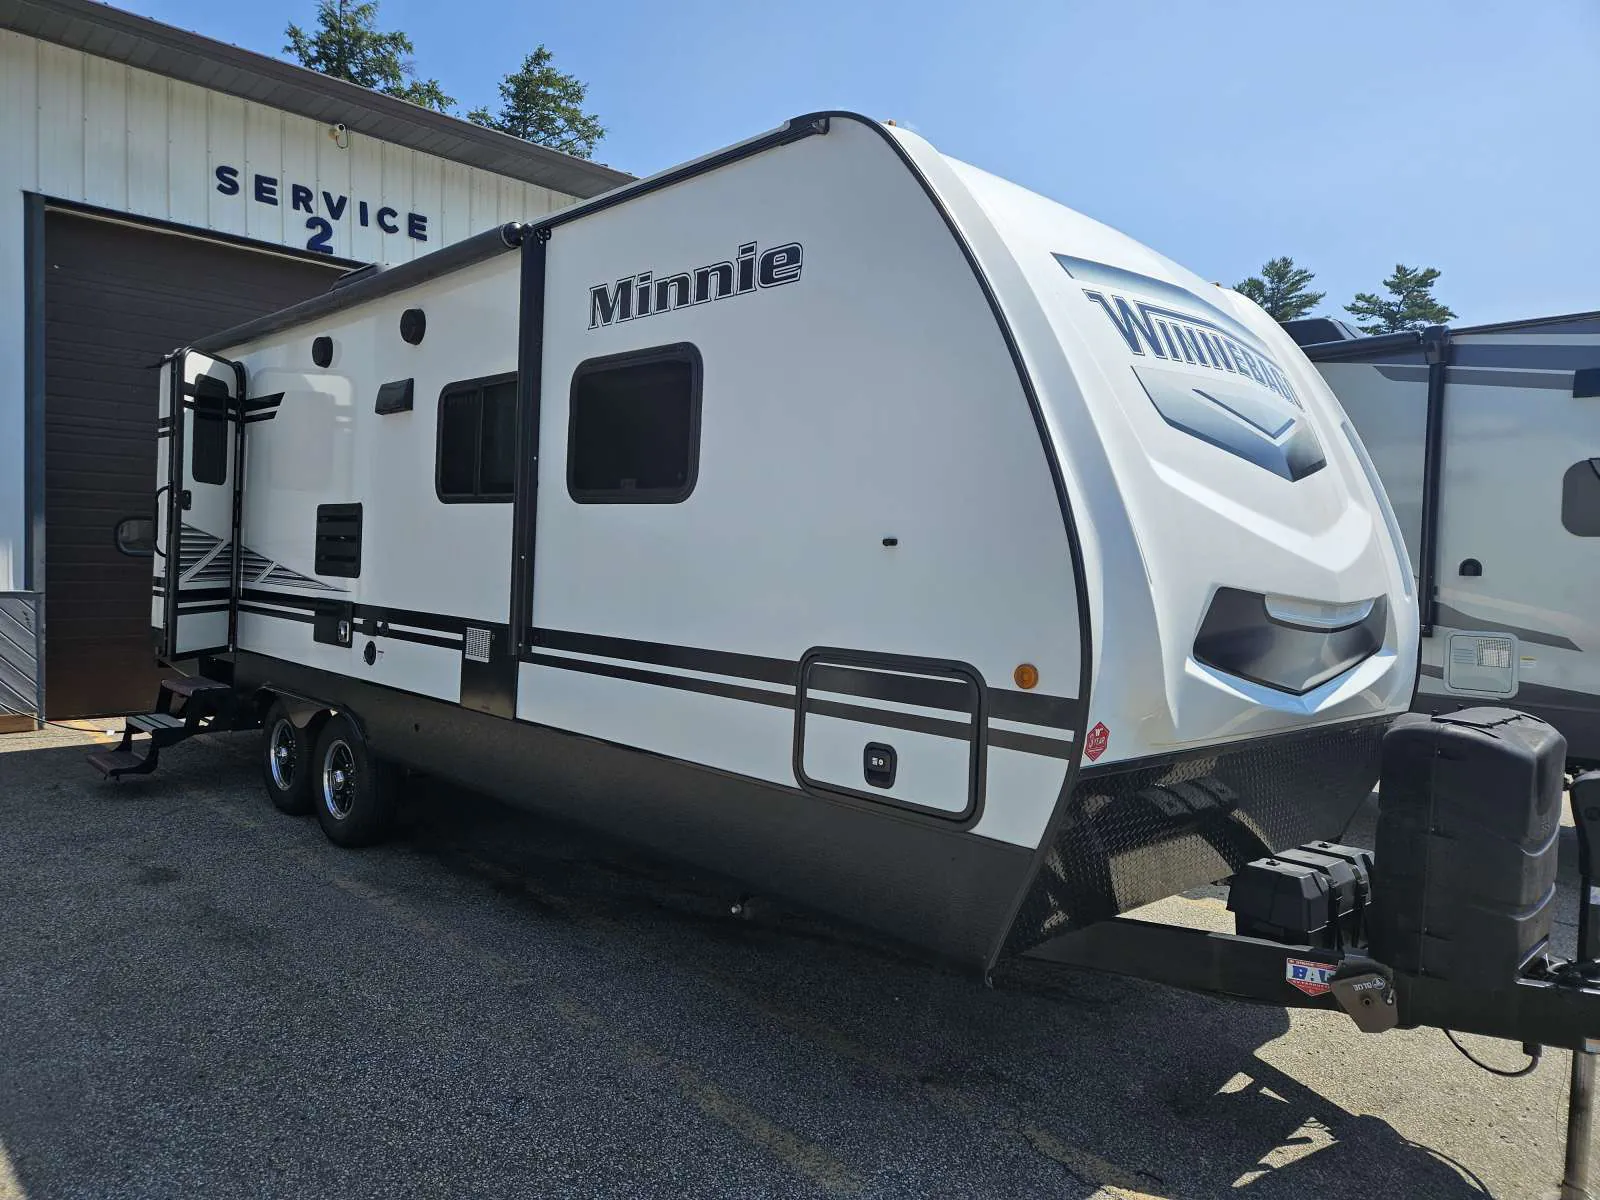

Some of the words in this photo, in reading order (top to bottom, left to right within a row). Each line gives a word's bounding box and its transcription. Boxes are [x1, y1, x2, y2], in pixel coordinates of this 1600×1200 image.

[215, 165, 428, 242] SERVICE
[305, 216, 334, 255] 2
[588, 240, 804, 330] Minnie
